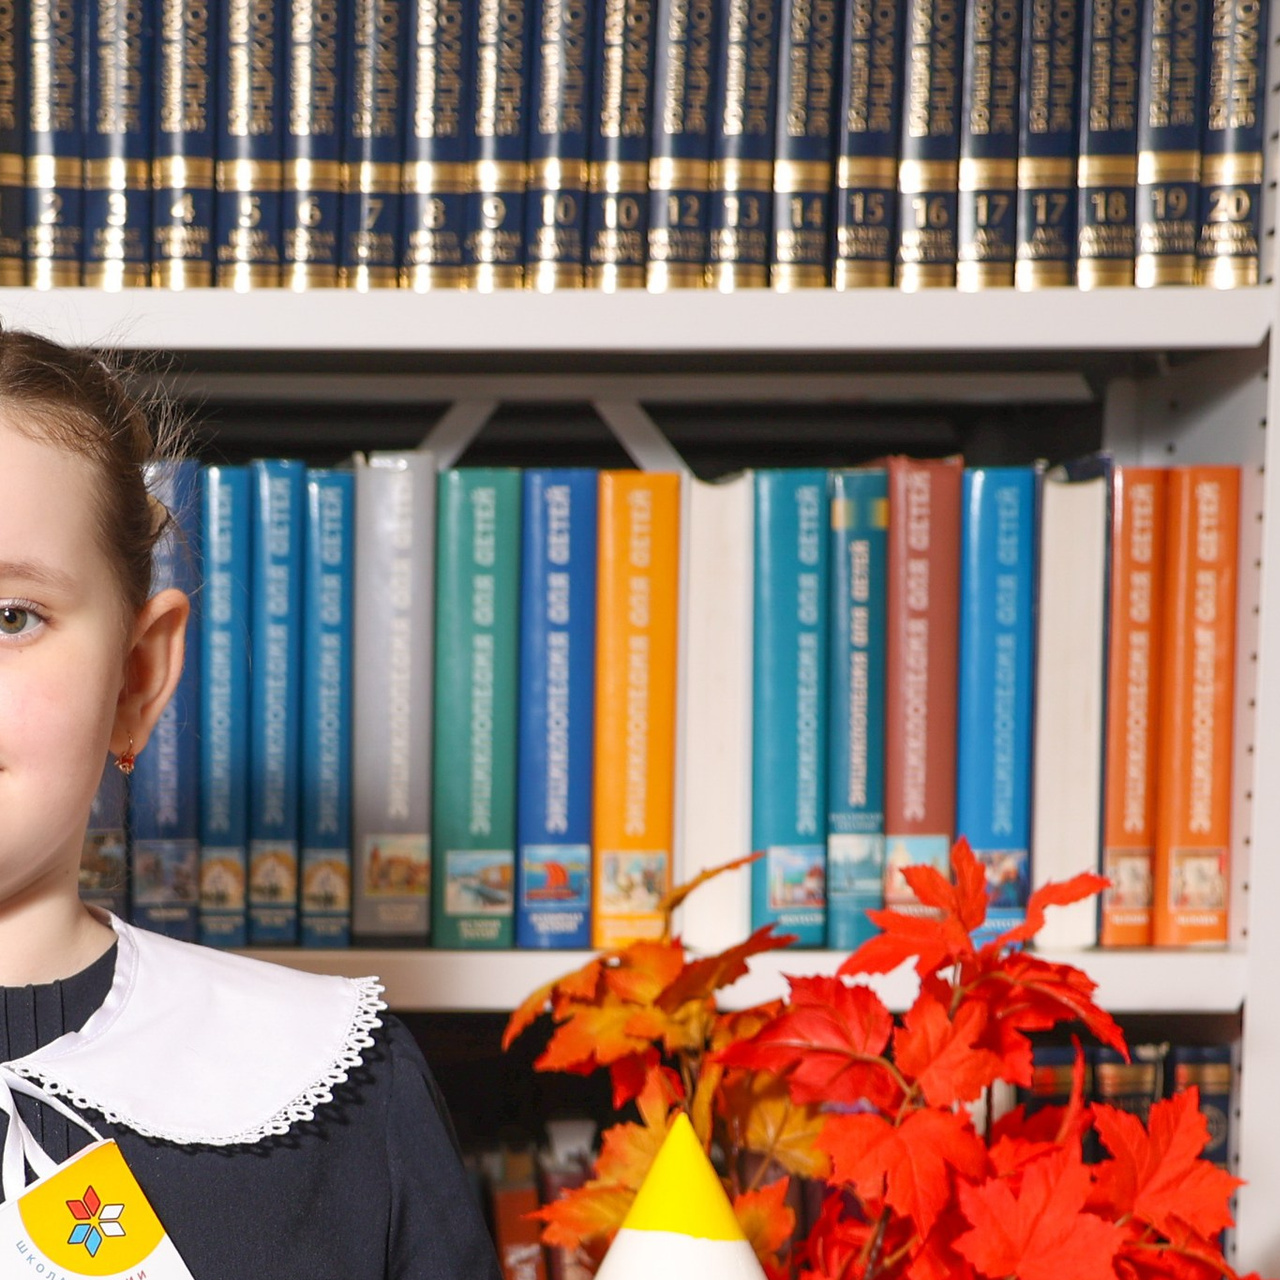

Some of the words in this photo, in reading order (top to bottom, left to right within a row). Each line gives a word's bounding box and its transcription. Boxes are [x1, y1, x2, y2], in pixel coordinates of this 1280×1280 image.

[364, 197, 385, 230] 7
[481, 195, 507, 229] 9
[541, 193, 577, 226] 10
[601, 196, 640, 230] 10
[666, 195, 700, 227] 12
[723, 195, 760, 228] 13
[790, 196, 824, 229] 14
[849, 192, 885, 225] 15
[911, 195, 949, 229] 16
[976, 194, 1010, 226] 17
[1032, 193, 1069, 225] 17
[1091, 190, 1128, 223] 18
[1150, 186, 1189, 220] 19
[1208, 188, 1251, 222] 20
